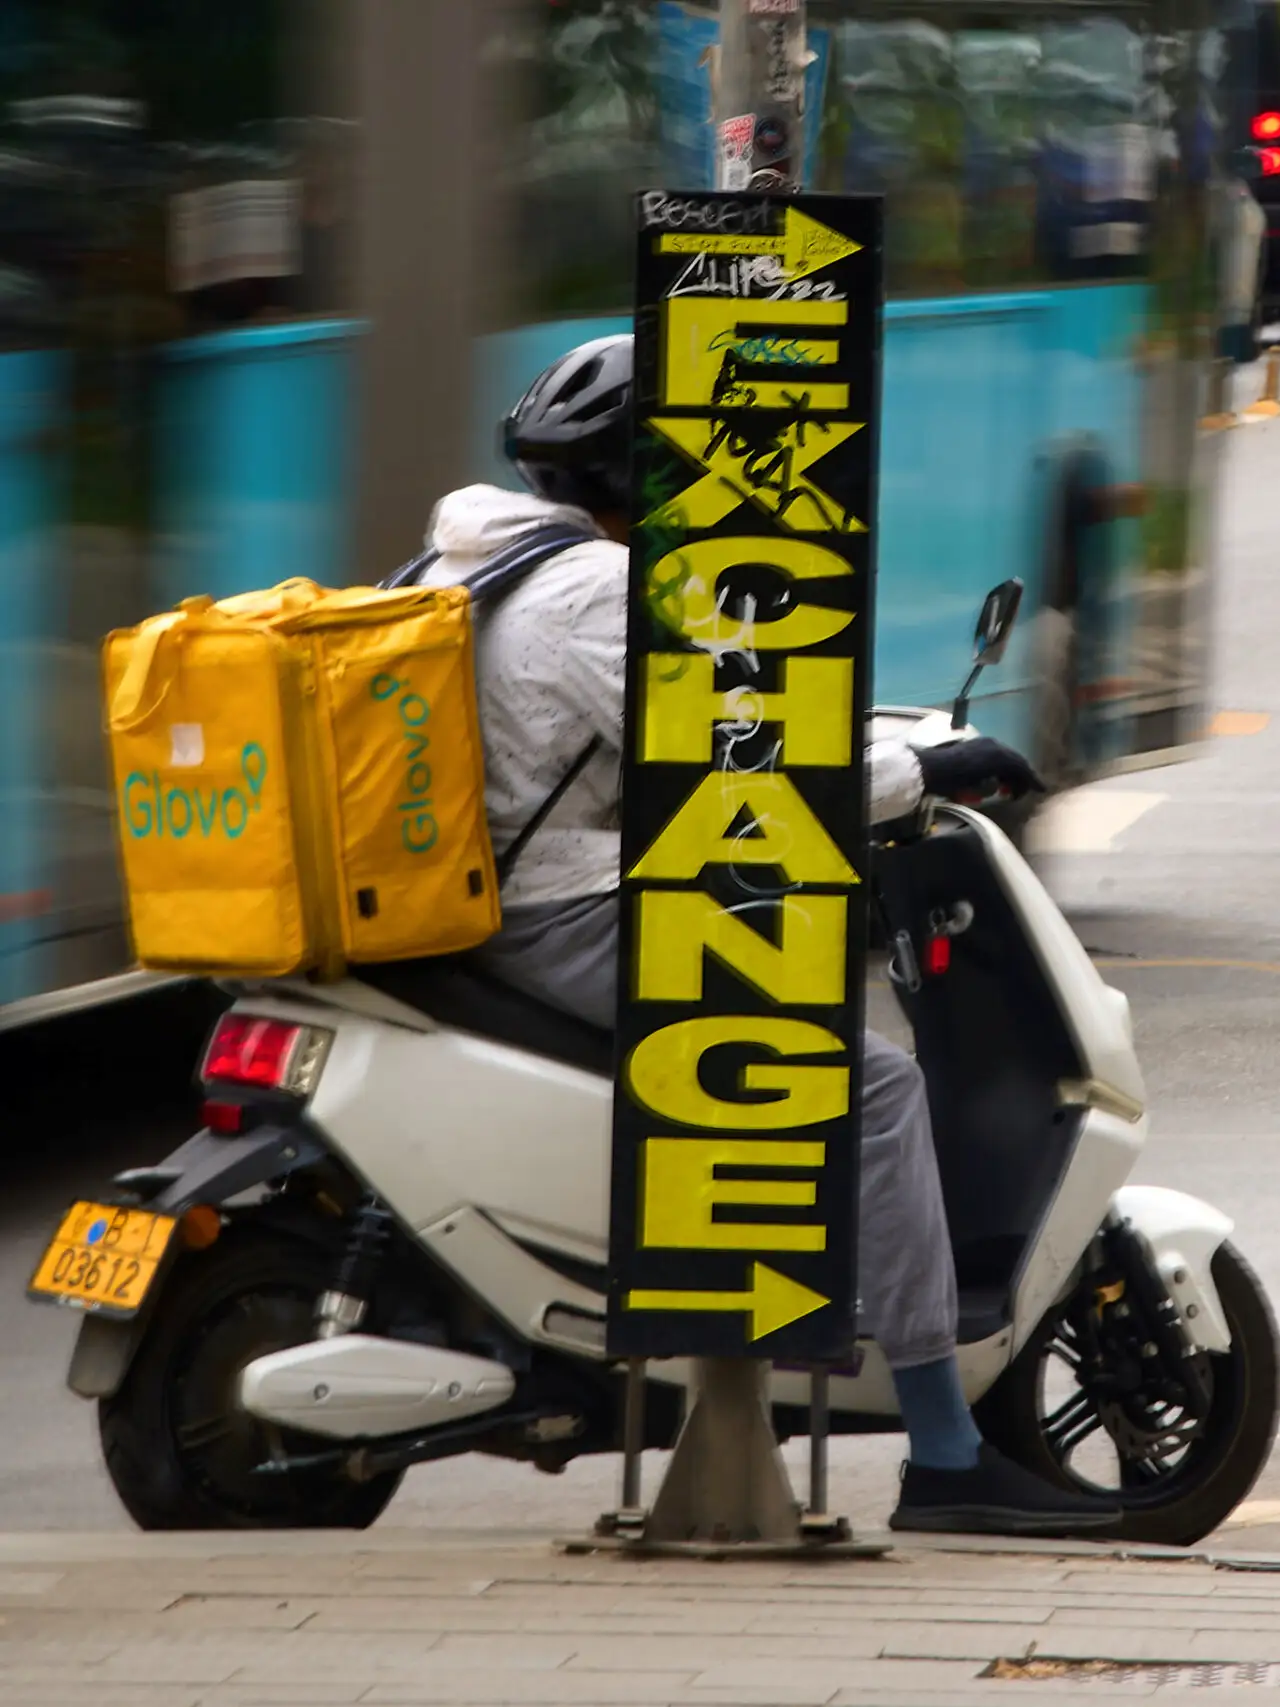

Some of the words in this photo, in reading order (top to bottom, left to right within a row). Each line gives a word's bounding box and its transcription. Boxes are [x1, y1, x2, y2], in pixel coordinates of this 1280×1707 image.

[122, 770, 251, 840] Glovo
[397, 693, 440, 854] Glovo
[626, 297, 867, 1251] EXCHANGE
[52, 1247, 141, 1299] 03612
